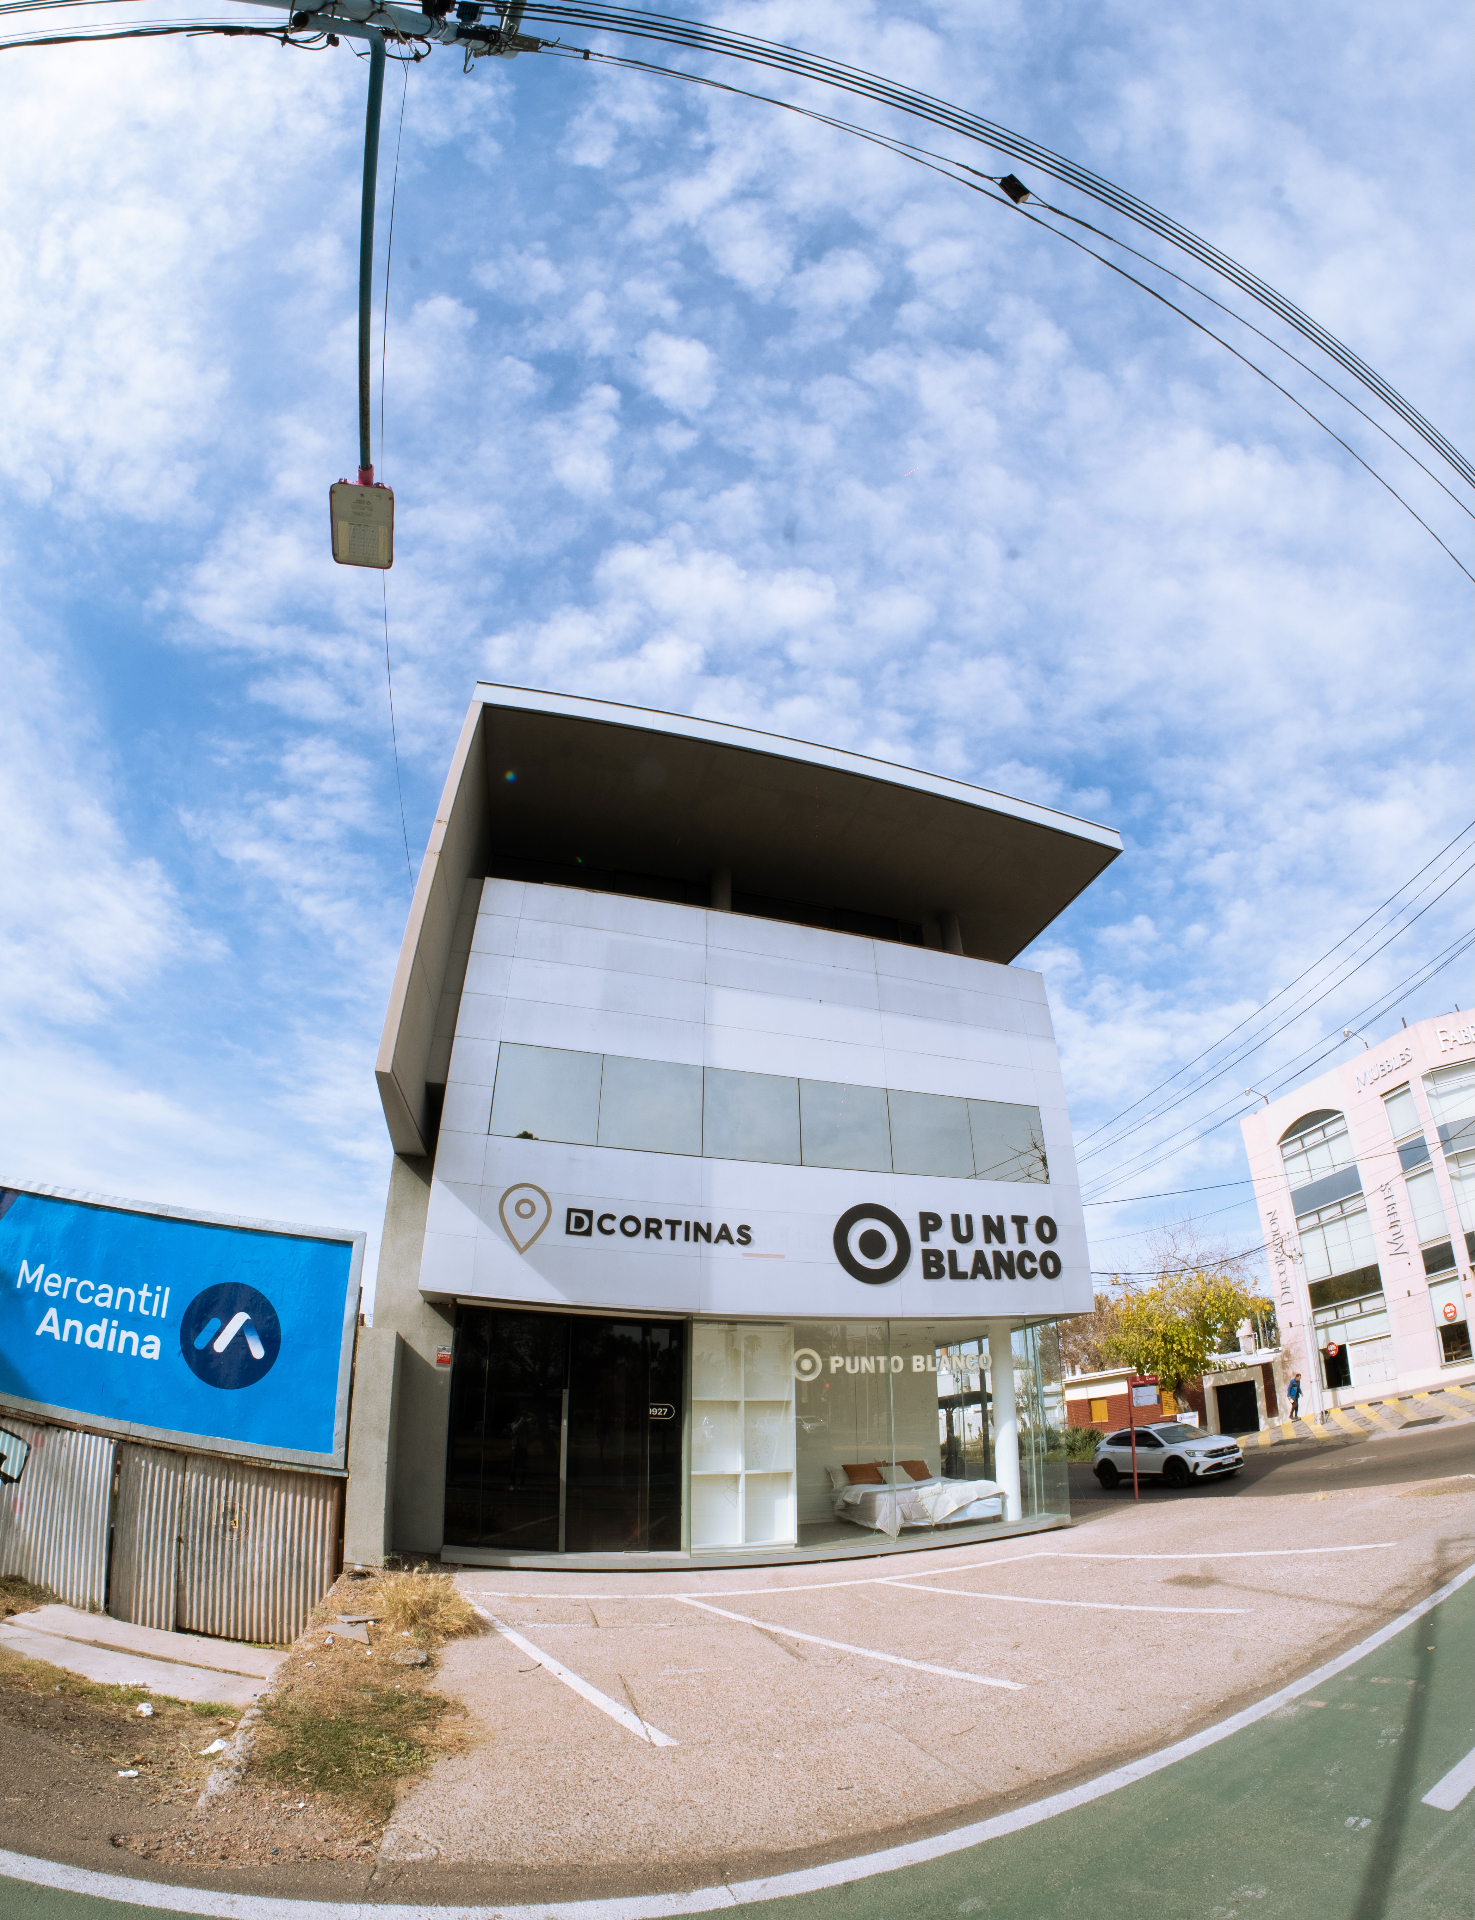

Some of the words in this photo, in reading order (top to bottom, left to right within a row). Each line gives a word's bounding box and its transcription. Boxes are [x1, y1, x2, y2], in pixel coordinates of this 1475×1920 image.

[1354, 1046, 1413, 1093] MUEBLES
[597, 1213, 752, 1245] CORTINAS
[919, 1211, 1057, 1244] PUNTO
[1380, 1182, 1409, 1256] MUEBLES
[921, 1248, 1061, 1280] BLANCO
[16, 1259, 170, 1318] Mercantil
[35, 1307, 161, 1360] Andina
[830, 1355, 904, 1374] PUNTO
[912, 1353, 992, 1373] BLANCO
